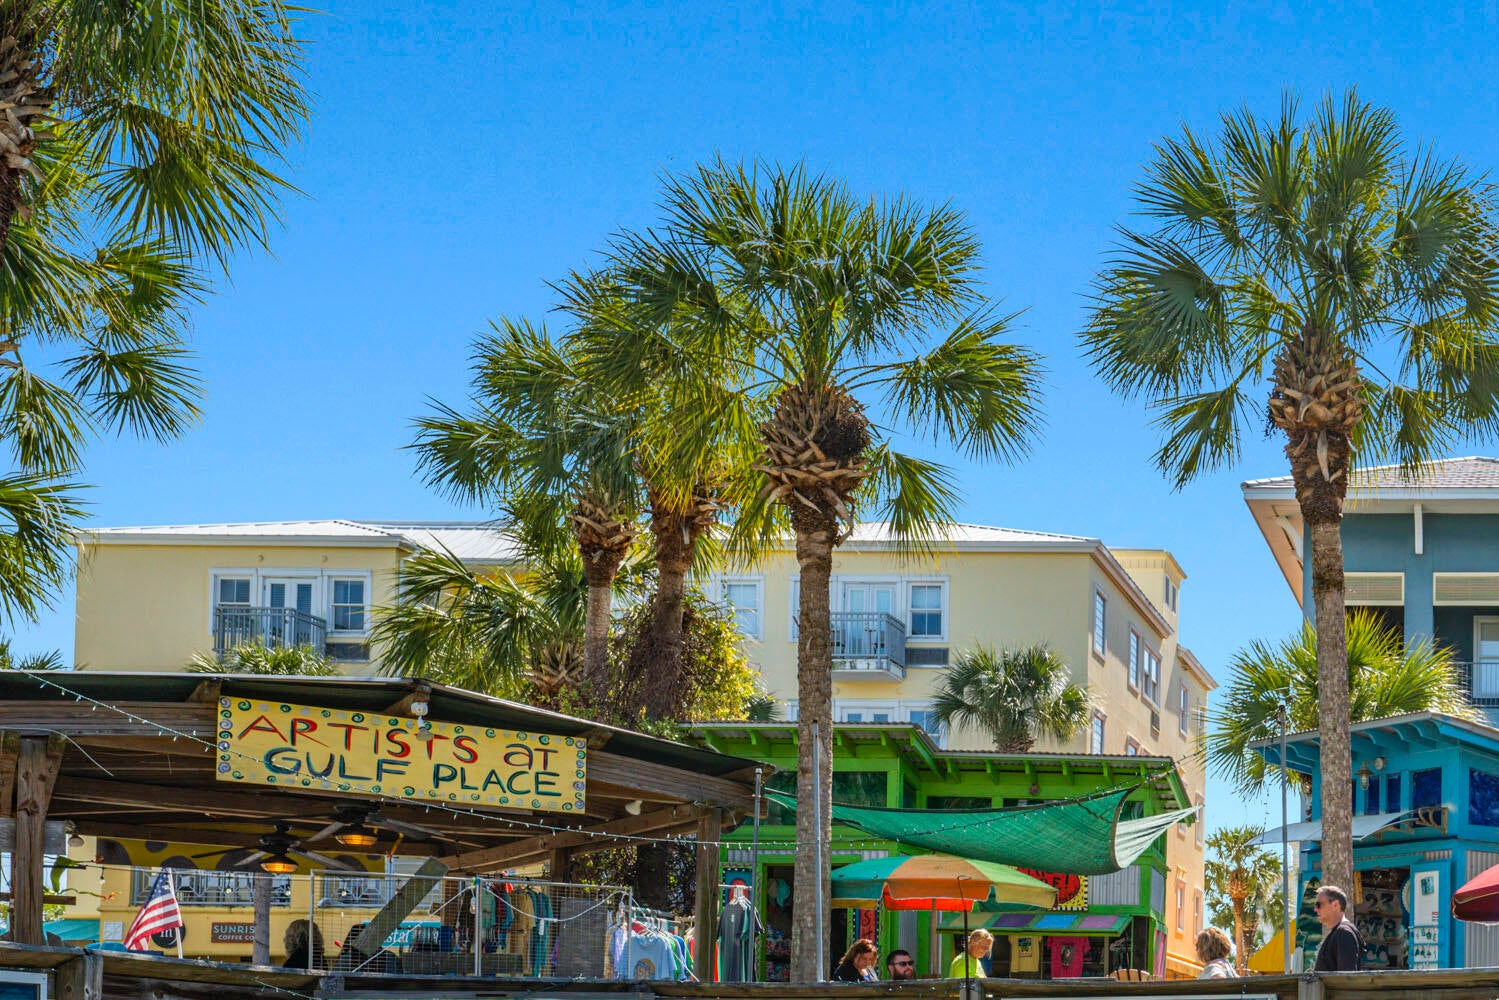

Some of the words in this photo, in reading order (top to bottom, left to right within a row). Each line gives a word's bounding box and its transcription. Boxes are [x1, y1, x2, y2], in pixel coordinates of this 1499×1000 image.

[238, 714, 479, 764] ARTISTS
[263, 746, 412, 782] GULF
[433, 763, 562, 797] PLACE
[213, 925, 255, 934] SUNRIS
